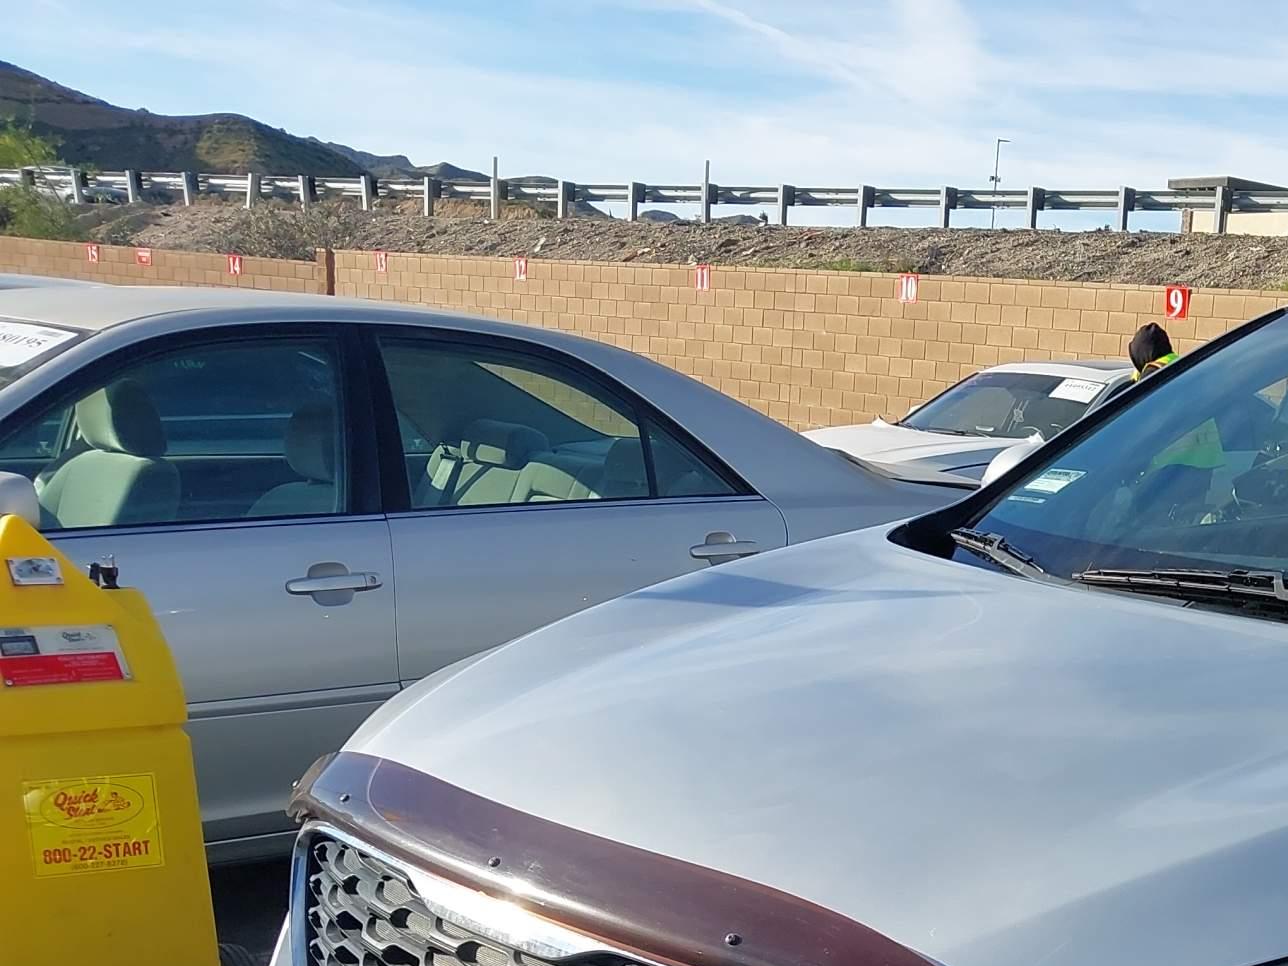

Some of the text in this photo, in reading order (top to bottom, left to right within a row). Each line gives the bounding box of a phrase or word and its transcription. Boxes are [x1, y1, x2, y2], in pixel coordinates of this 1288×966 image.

[86, 244, 98, 263] 15
[376, 252, 387, 272] 13
[229, 256, 242, 275] 14
[515, 259, 527, 281] 12
[697, 268, 709, 290] 11
[901, 276, 918, 301] 10
[1168, 288, 1184, 317] 9
[0, 331, 49, 348] 80195
[42, 839, 151, 865] 800-22-START
